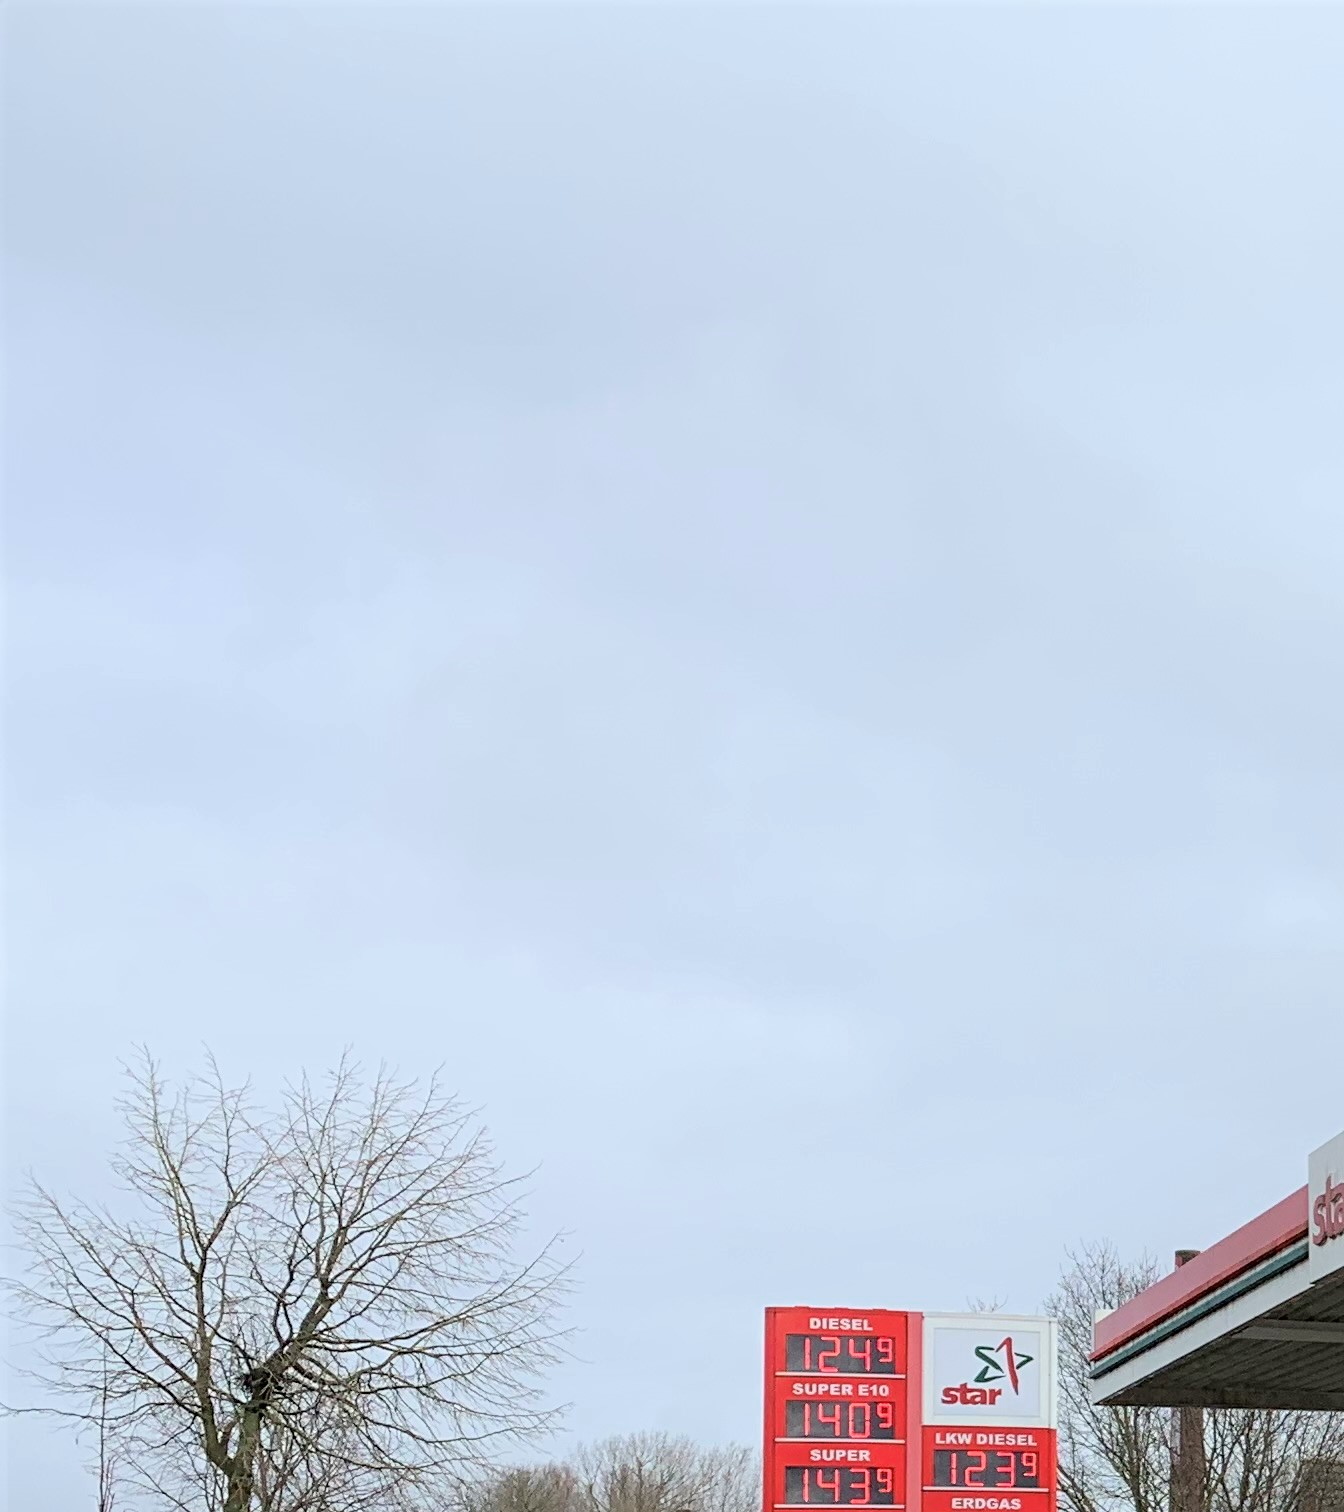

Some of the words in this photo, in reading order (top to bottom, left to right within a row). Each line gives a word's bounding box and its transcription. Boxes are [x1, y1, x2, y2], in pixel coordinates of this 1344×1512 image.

[809, 1318, 873, 1331] DIESEL
[804, 1336, 893, 1373] 1249
[792, 1383, 853, 1397] SUPER
[858, 1384, 889, 1397] E10
[941, 1383, 1002, 1405] star
[804, 1402, 893, 1438] 1409
[935, 1433, 972, 1446] LKW
[976, 1433, 1038, 1447] DIESEL
[810, 1449, 871, 1462] SUPER
[950, 1450, 1038, 1488] 1239
[803, 1468, 893, 1504] 1439
[951, 1498, 1021, 1511] ERDGAS
